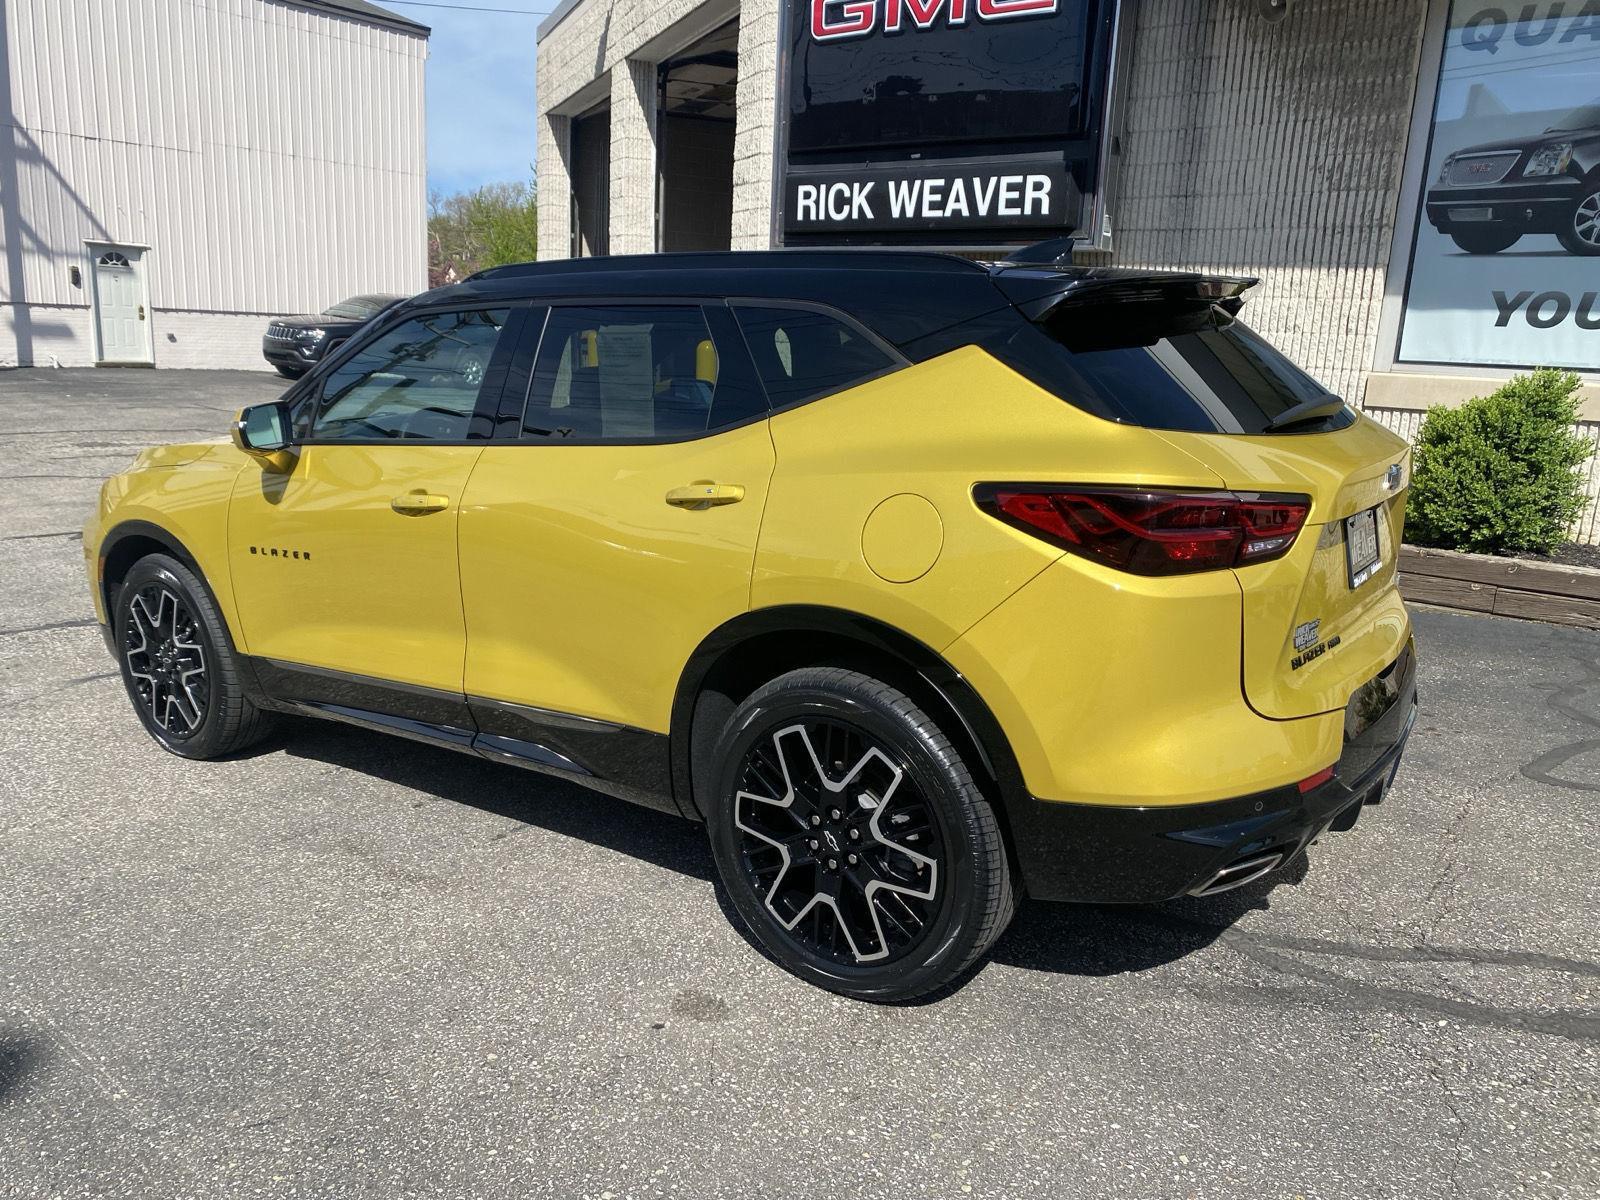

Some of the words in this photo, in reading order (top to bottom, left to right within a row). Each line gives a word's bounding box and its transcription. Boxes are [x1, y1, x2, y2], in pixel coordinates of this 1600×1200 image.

[797, 182, 876, 221] RICK
[888, 174, 1052, 219] WEAVER
[249, 546, 311, 561] BLAZER
